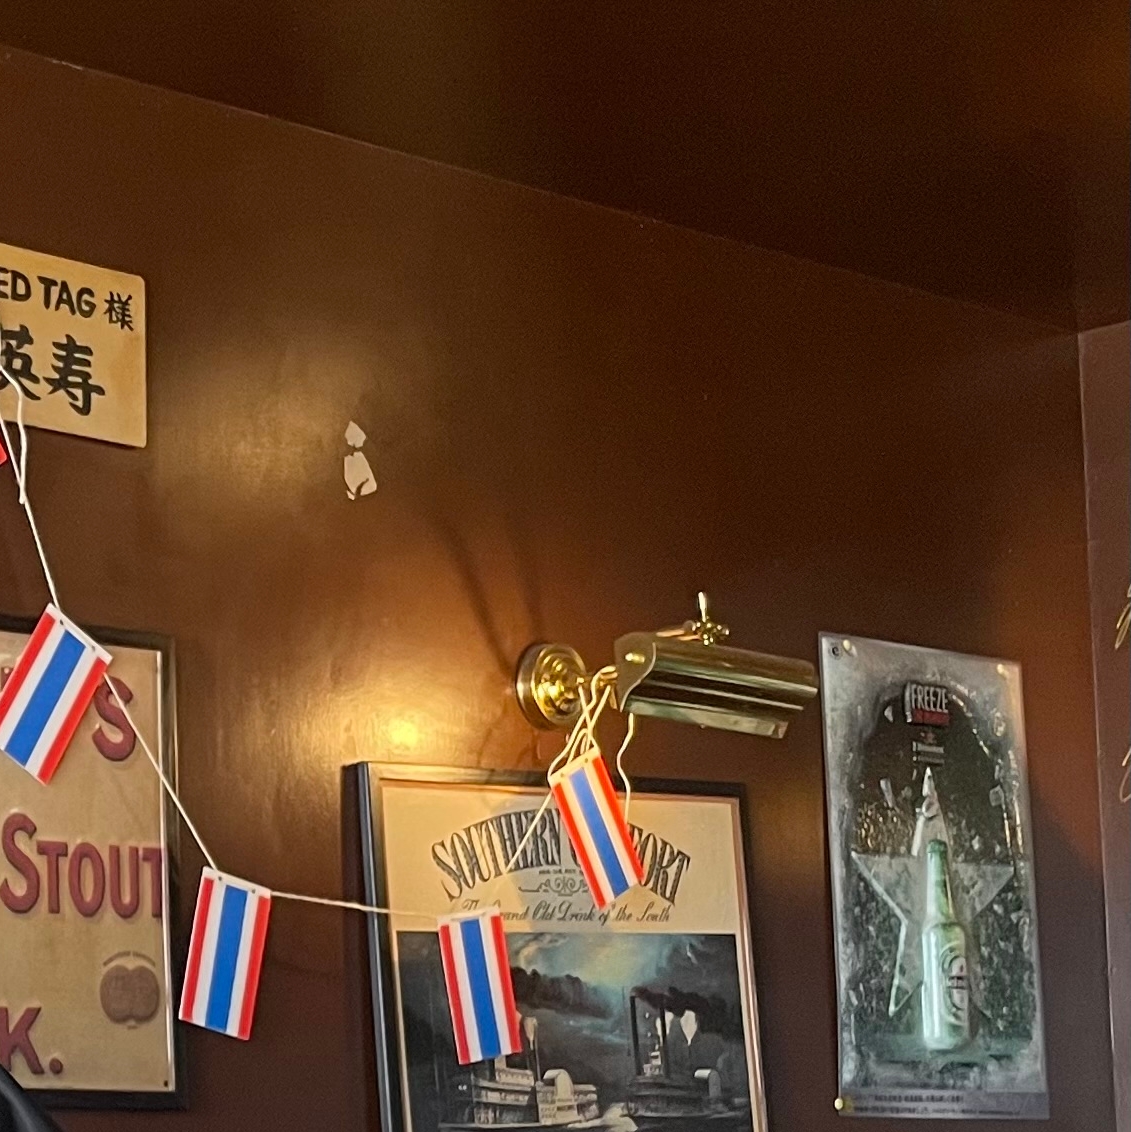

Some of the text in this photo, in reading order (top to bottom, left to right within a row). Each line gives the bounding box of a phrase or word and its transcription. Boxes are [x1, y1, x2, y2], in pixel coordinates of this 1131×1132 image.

[37, 275, 97, 318] TAG
[103, 290, 134, 332] 様
[911, 683, 949, 714] FREEZE
[431, 807, 562, 902] SOUTHERN
[532, 901, 556, 921] Old
[556, 902, 595, 922] Drink
[598, 902, 613, 925] of
[616, 901, 633, 921] the
[637, 901, 671, 922] South
